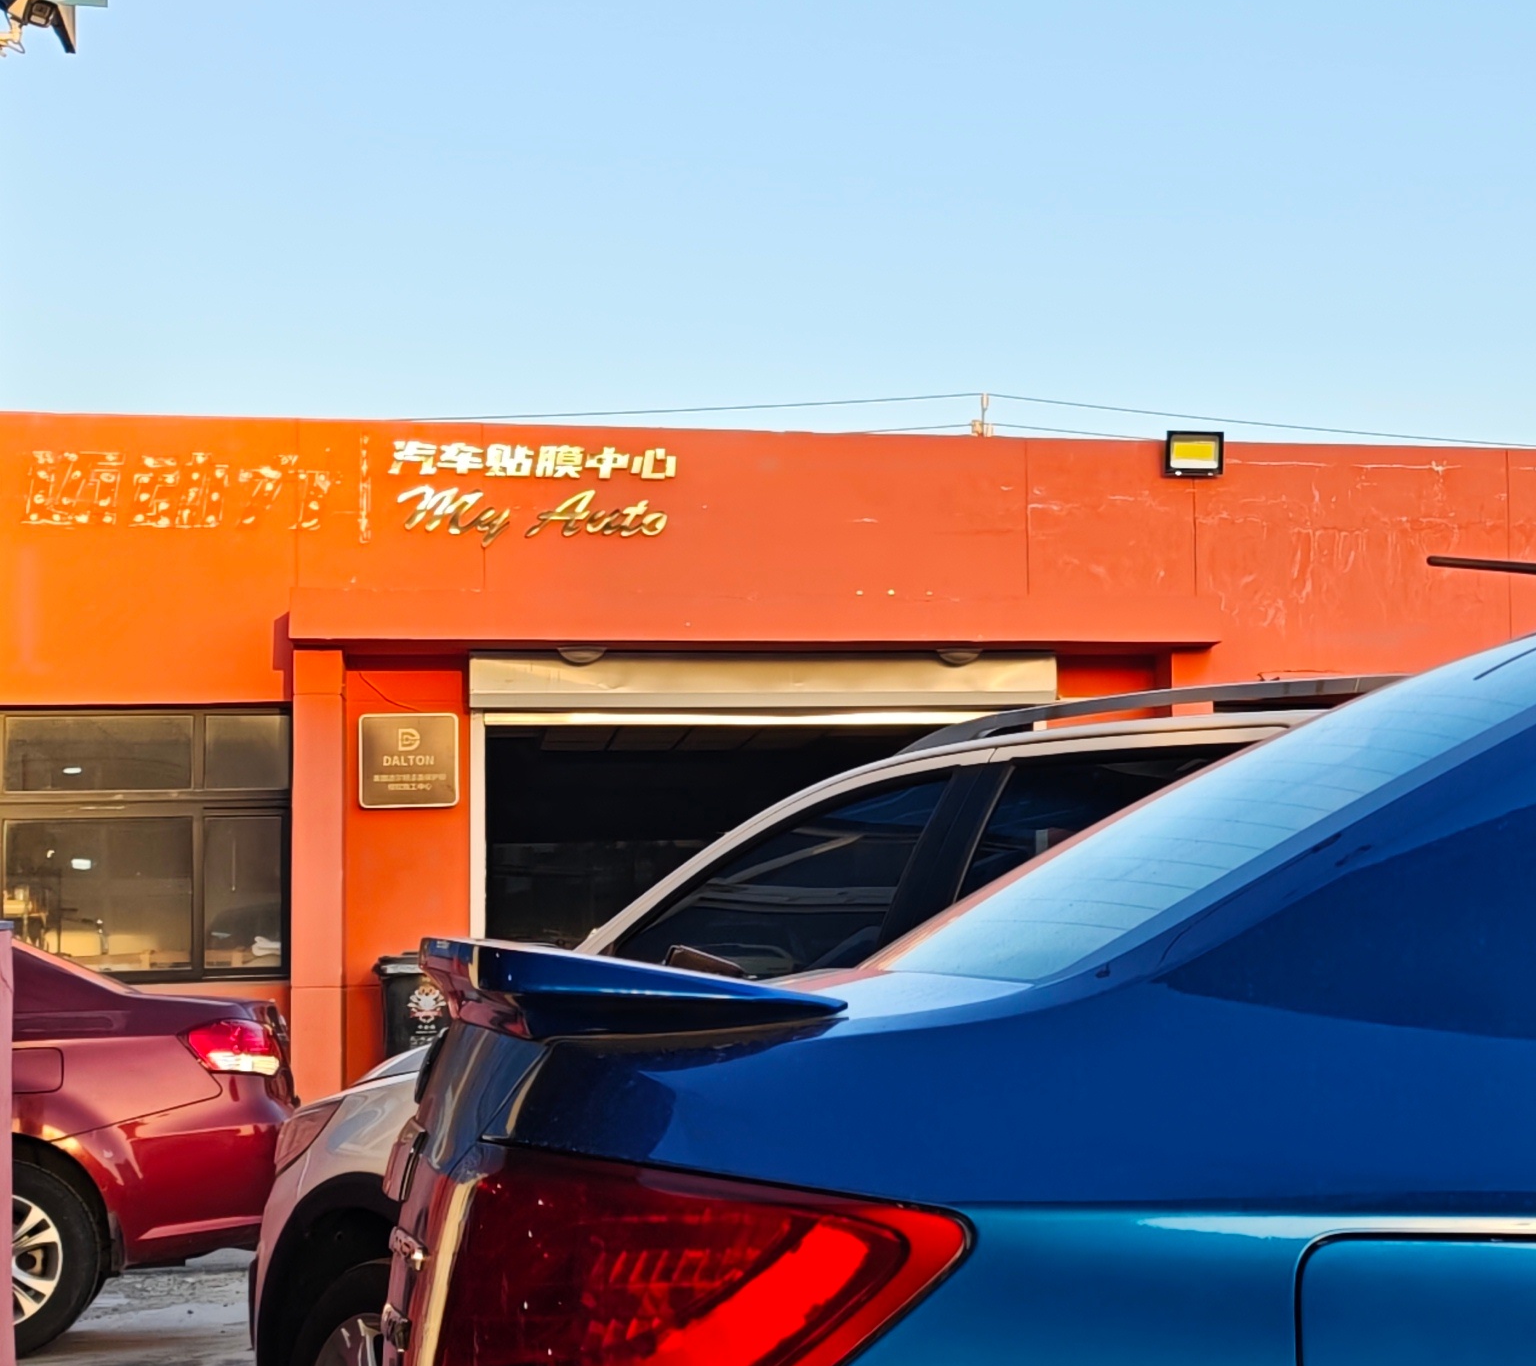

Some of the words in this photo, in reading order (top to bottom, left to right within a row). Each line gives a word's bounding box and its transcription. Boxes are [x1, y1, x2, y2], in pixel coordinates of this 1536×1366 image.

[387, 440, 677, 480] 汽车贴膜中心
[397, 485, 510, 547] My
[524, 488, 667, 538] Auto
[382, 755, 435, 766] DALTON
